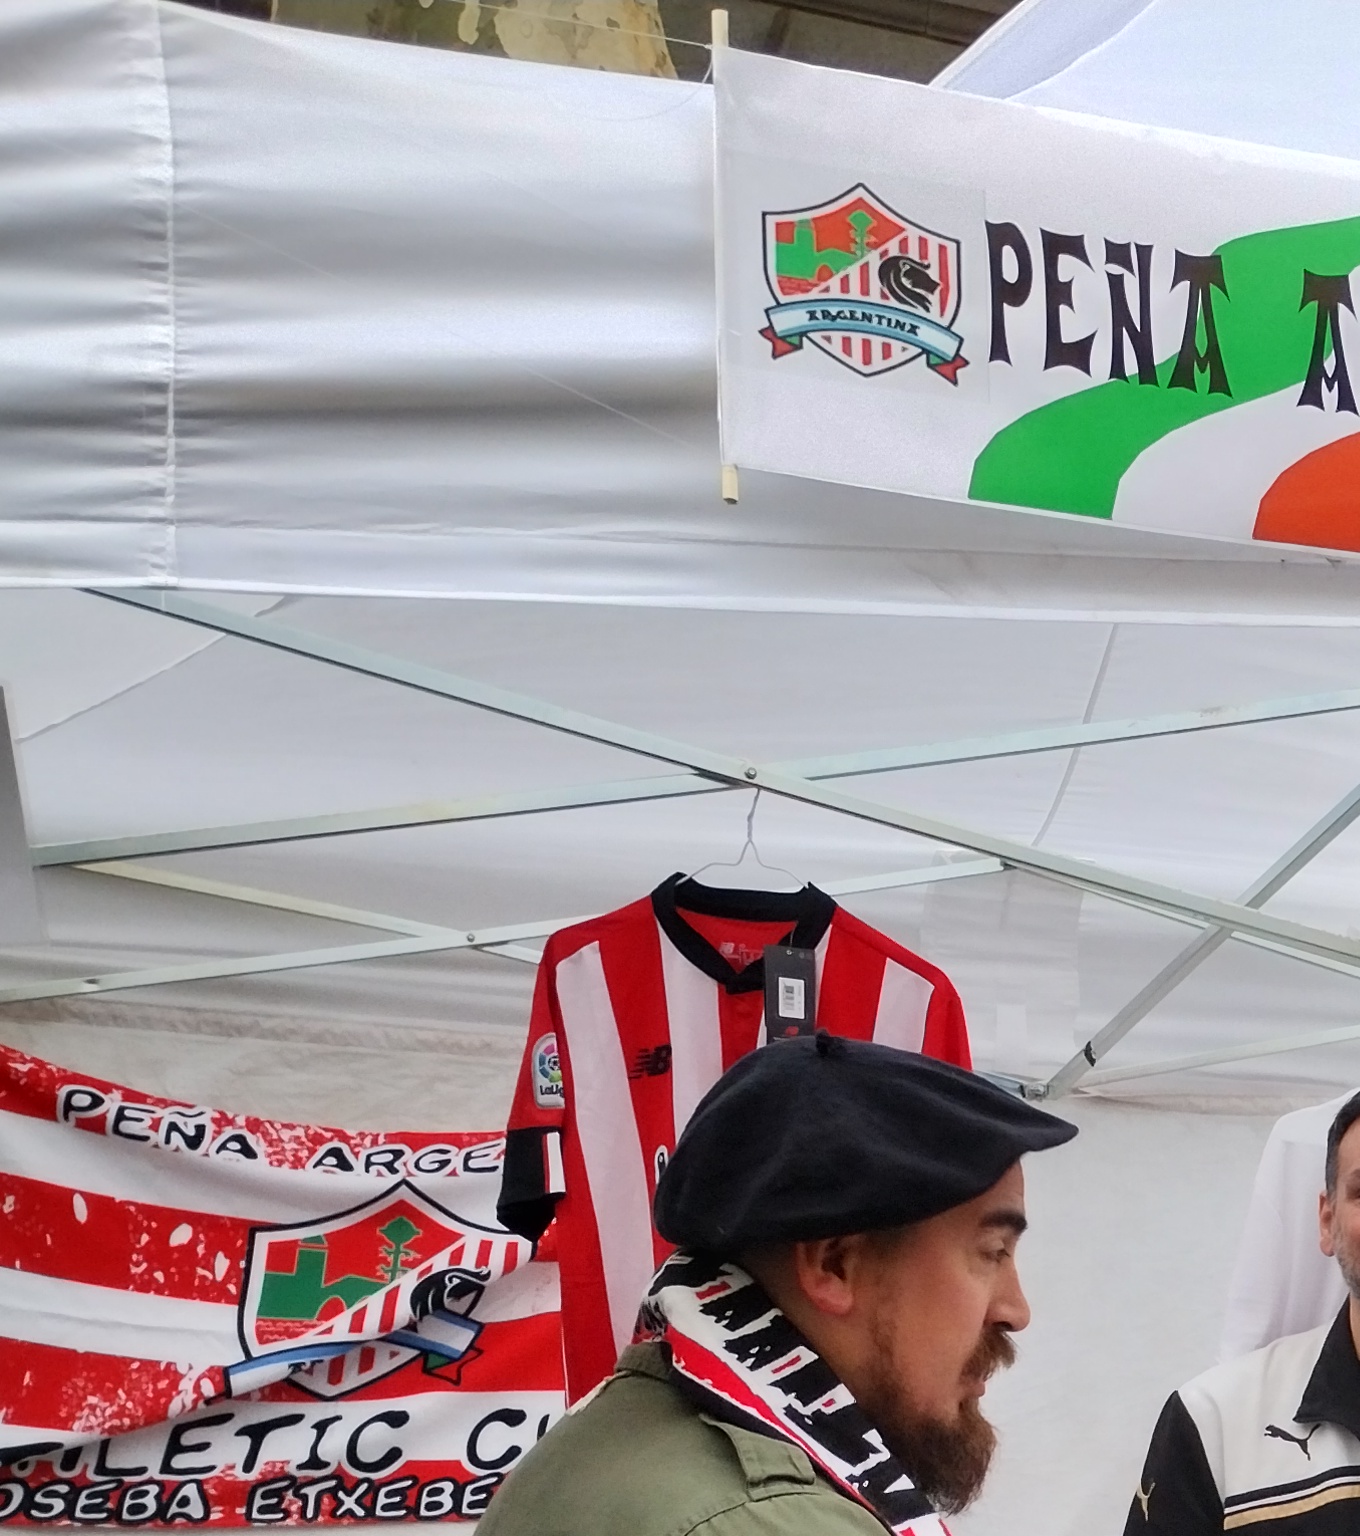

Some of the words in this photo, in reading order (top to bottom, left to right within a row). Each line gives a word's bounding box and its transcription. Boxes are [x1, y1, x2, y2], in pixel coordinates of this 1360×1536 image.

[983, 218, 1233, 398] PEÑA
[62, 1087, 260, 1160] PEÑA
[466, 1408, 550, 1471] C
